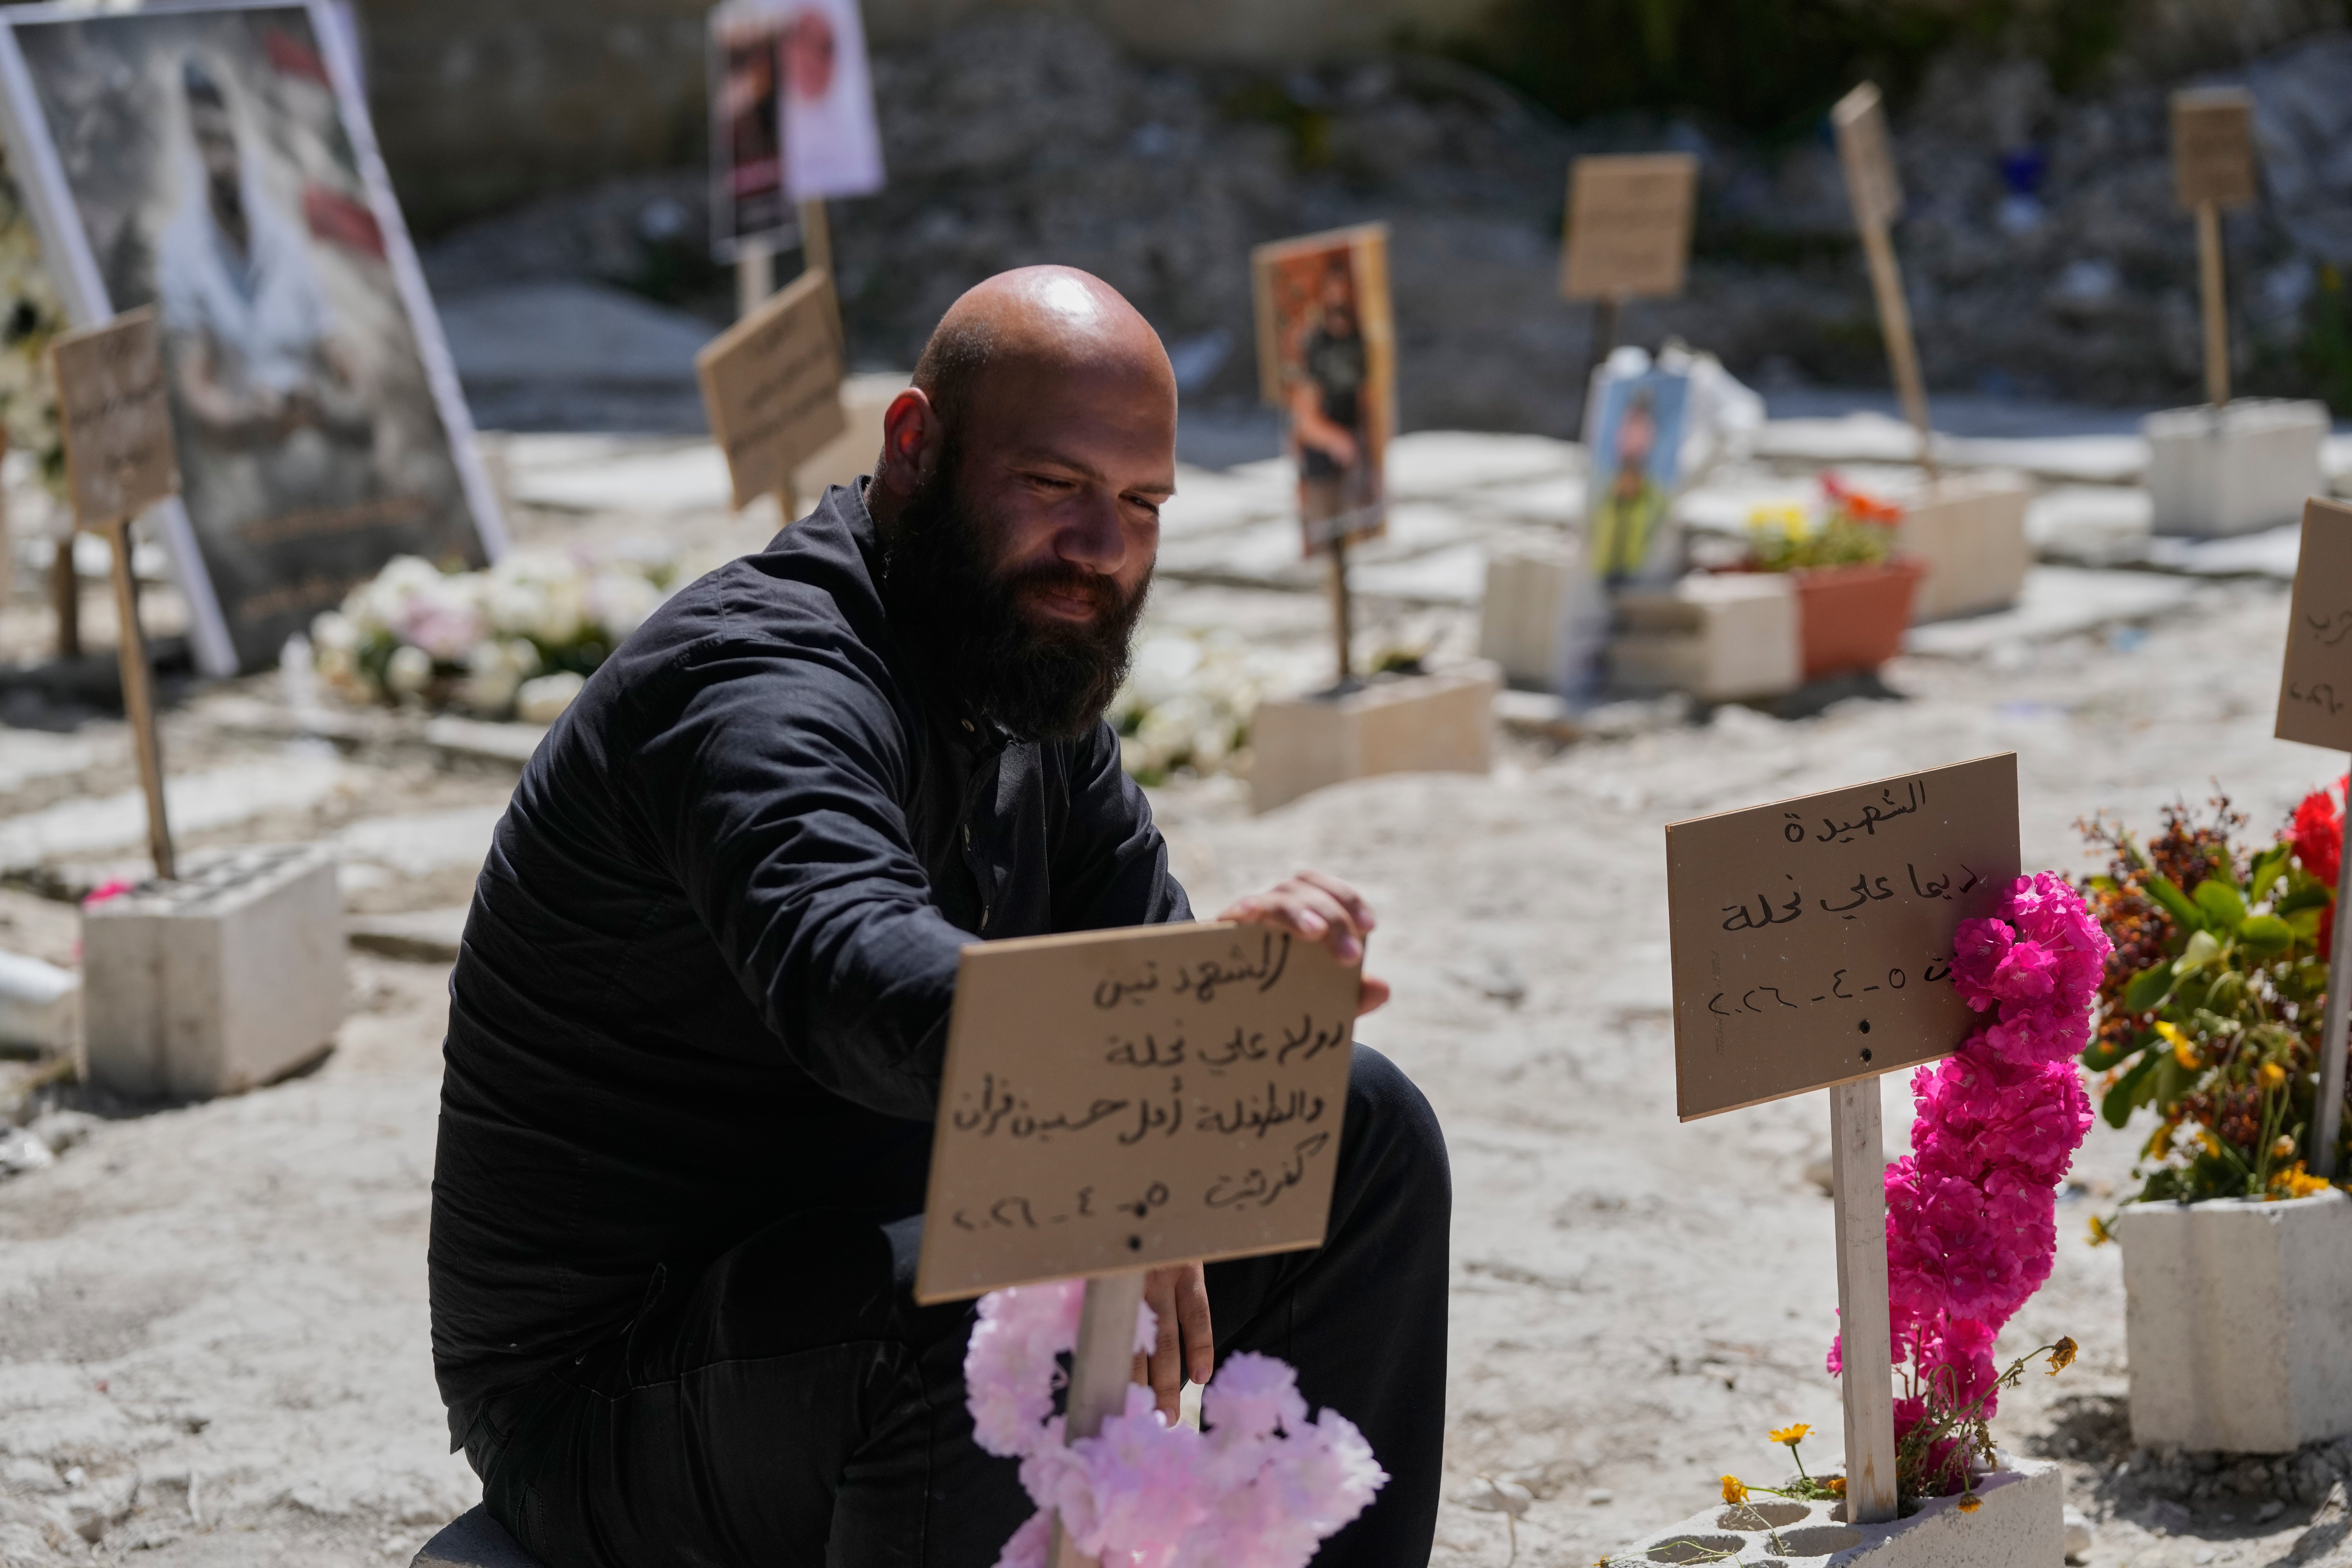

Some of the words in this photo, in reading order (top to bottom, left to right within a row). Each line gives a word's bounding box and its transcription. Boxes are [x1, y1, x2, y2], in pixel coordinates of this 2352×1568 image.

[1784, 779, 1926, 843] الشهيدة
[1722, 874, 1802, 931] نحلة
[1820, 873, 1894, 920] علي
[1105, 1018, 1186, 1068] نحلة
[1196, 1026, 1269, 1076] علي
[1010, 1097, 1131, 1142] حسين
[1196, 1081, 1325, 1138] والطفلة
